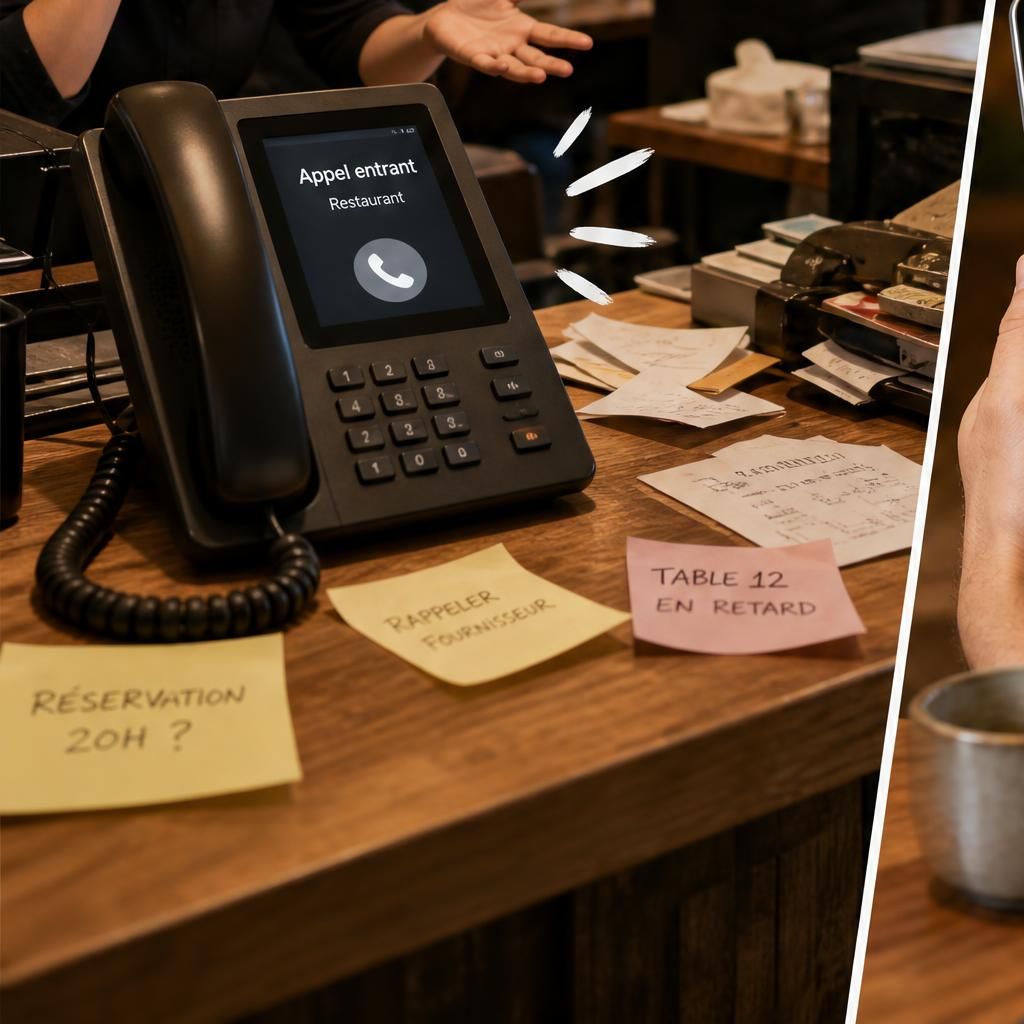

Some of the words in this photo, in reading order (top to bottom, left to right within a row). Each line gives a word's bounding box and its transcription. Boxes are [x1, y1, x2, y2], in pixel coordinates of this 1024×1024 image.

[299, 164, 351, 187] Appel
[354, 158, 418, 179] entrant
[328, 191, 406, 211] Restaurant
[651, 567, 738, 587] TABLE
[748, 571, 789, 589] 12
[384, 590, 500, 633] RAPPELER
[656, 597, 694, 613] EN
[712, 599, 817, 617] RETARD
[421, 598, 557, 650] FOURNISSEUR
[31, 684, 246, 716] RÉSERVATION
[64, 726, 147, 755] 20H
[170, 719, 193, 753] ?
